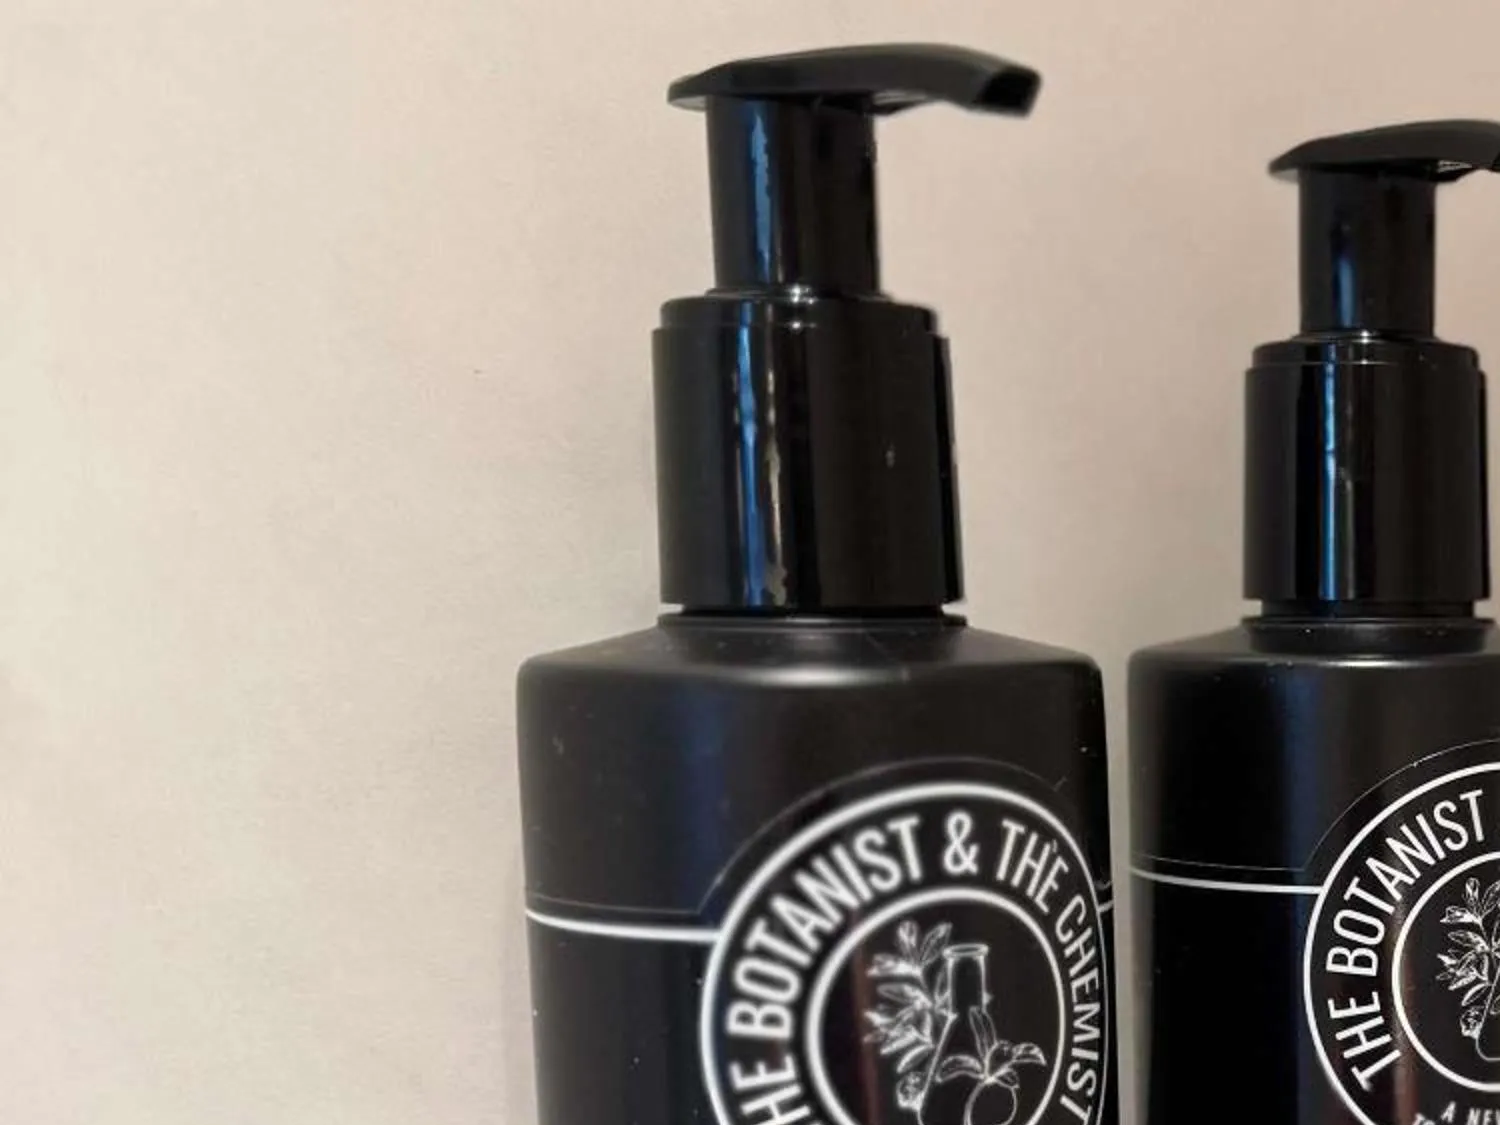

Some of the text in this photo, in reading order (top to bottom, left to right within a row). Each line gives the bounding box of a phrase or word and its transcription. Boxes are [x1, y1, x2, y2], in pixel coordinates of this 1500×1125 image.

[727, 815, 923, 1039] BOTANIST
[942, 811, 979, 875] &
[995, 819, 1070, 915] THE
[1325, 788, 1485, 978] BOTANIST
[1327, 991, 1402, 1092] THE
[1440, 1101, 1456, 1124] A
